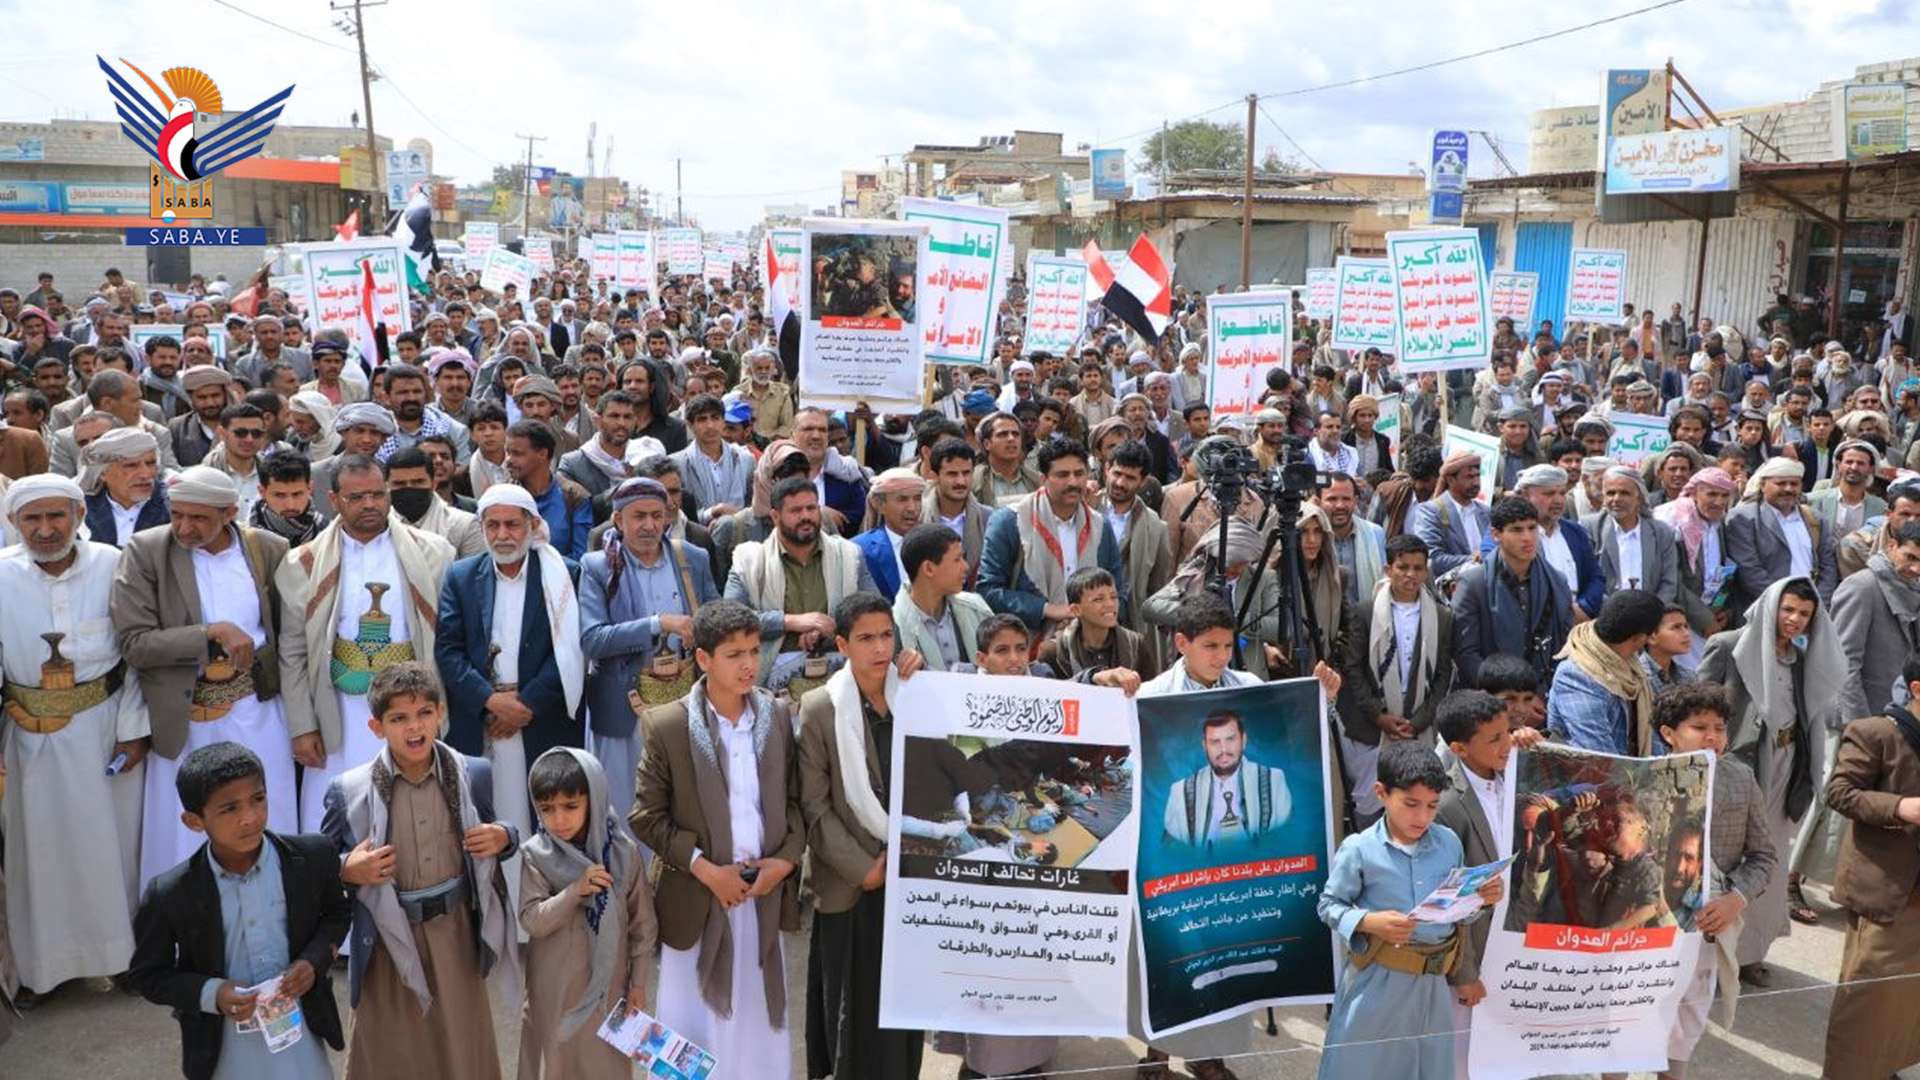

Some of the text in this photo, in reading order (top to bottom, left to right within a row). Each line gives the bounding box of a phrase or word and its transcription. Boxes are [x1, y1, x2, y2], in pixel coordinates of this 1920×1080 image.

[1618, 99, 1661, 124] الأمين
[1400, 243, 1474, 271] الله أكبر
[1444, 270, 1477, 286] الموت
[1446, 291, 1479, 307] الموت
[1436, 314, 1450, 329] على
[1456, 311, 1480, 324] اللعنة
[1217, 313, 1282, 341] قاطعوا
[1447, 329, 1481, 353] النصر
[1611, 429, 1649, 454] أكبر
[935, 860, 1080, 887] غارات تحالف العدوان
[1151, 858, 1307, 898] العدوان على بلدنا كان بإشراف أمريكي
[1219, 890, 1253, 904] أمريكية
[1255, 886, 1275, 898] خطة
[1299, 883, 1317, 898] وفي
[906, 892, 1119, 918] قتلت الناس في بيوتهم سواء في المدن
[1147, 905, 1180, 921] بريطانية
[901, 914, 985, 932] والمستشفيات
[1179, 908, 1282, 933] وتنفيذ من جانب التحالف
[990, 924, 1038, 935] الأسواق
[1107, 926, 1118, 943] أو
[1556, 929, 1648, 951] جرائم العدوان
[938, 940, 1116, 964] والمساجد والمدارس والطرقات
[1505, 959, 1539, 971] العالم
[1542, 963, 1562, 975] بها
[1593, 964, 1623, 975] وحشية
[1625, 962, 1653, 974] جرائم
[1655, 959, 1680, 969] هناك
[1500, 978, 1674, 996] وانتشرت أخبارها في مختلف البلدان
[1510, 998, 1549, 1012] الإنسانية
[1549, 1002, 1570, 1012] جبين
[1573, 1000, 1586, 1010] لها
[1609, 998, 1625, 1007] منها
[1626, 995, 1655, 1007] والكثير
